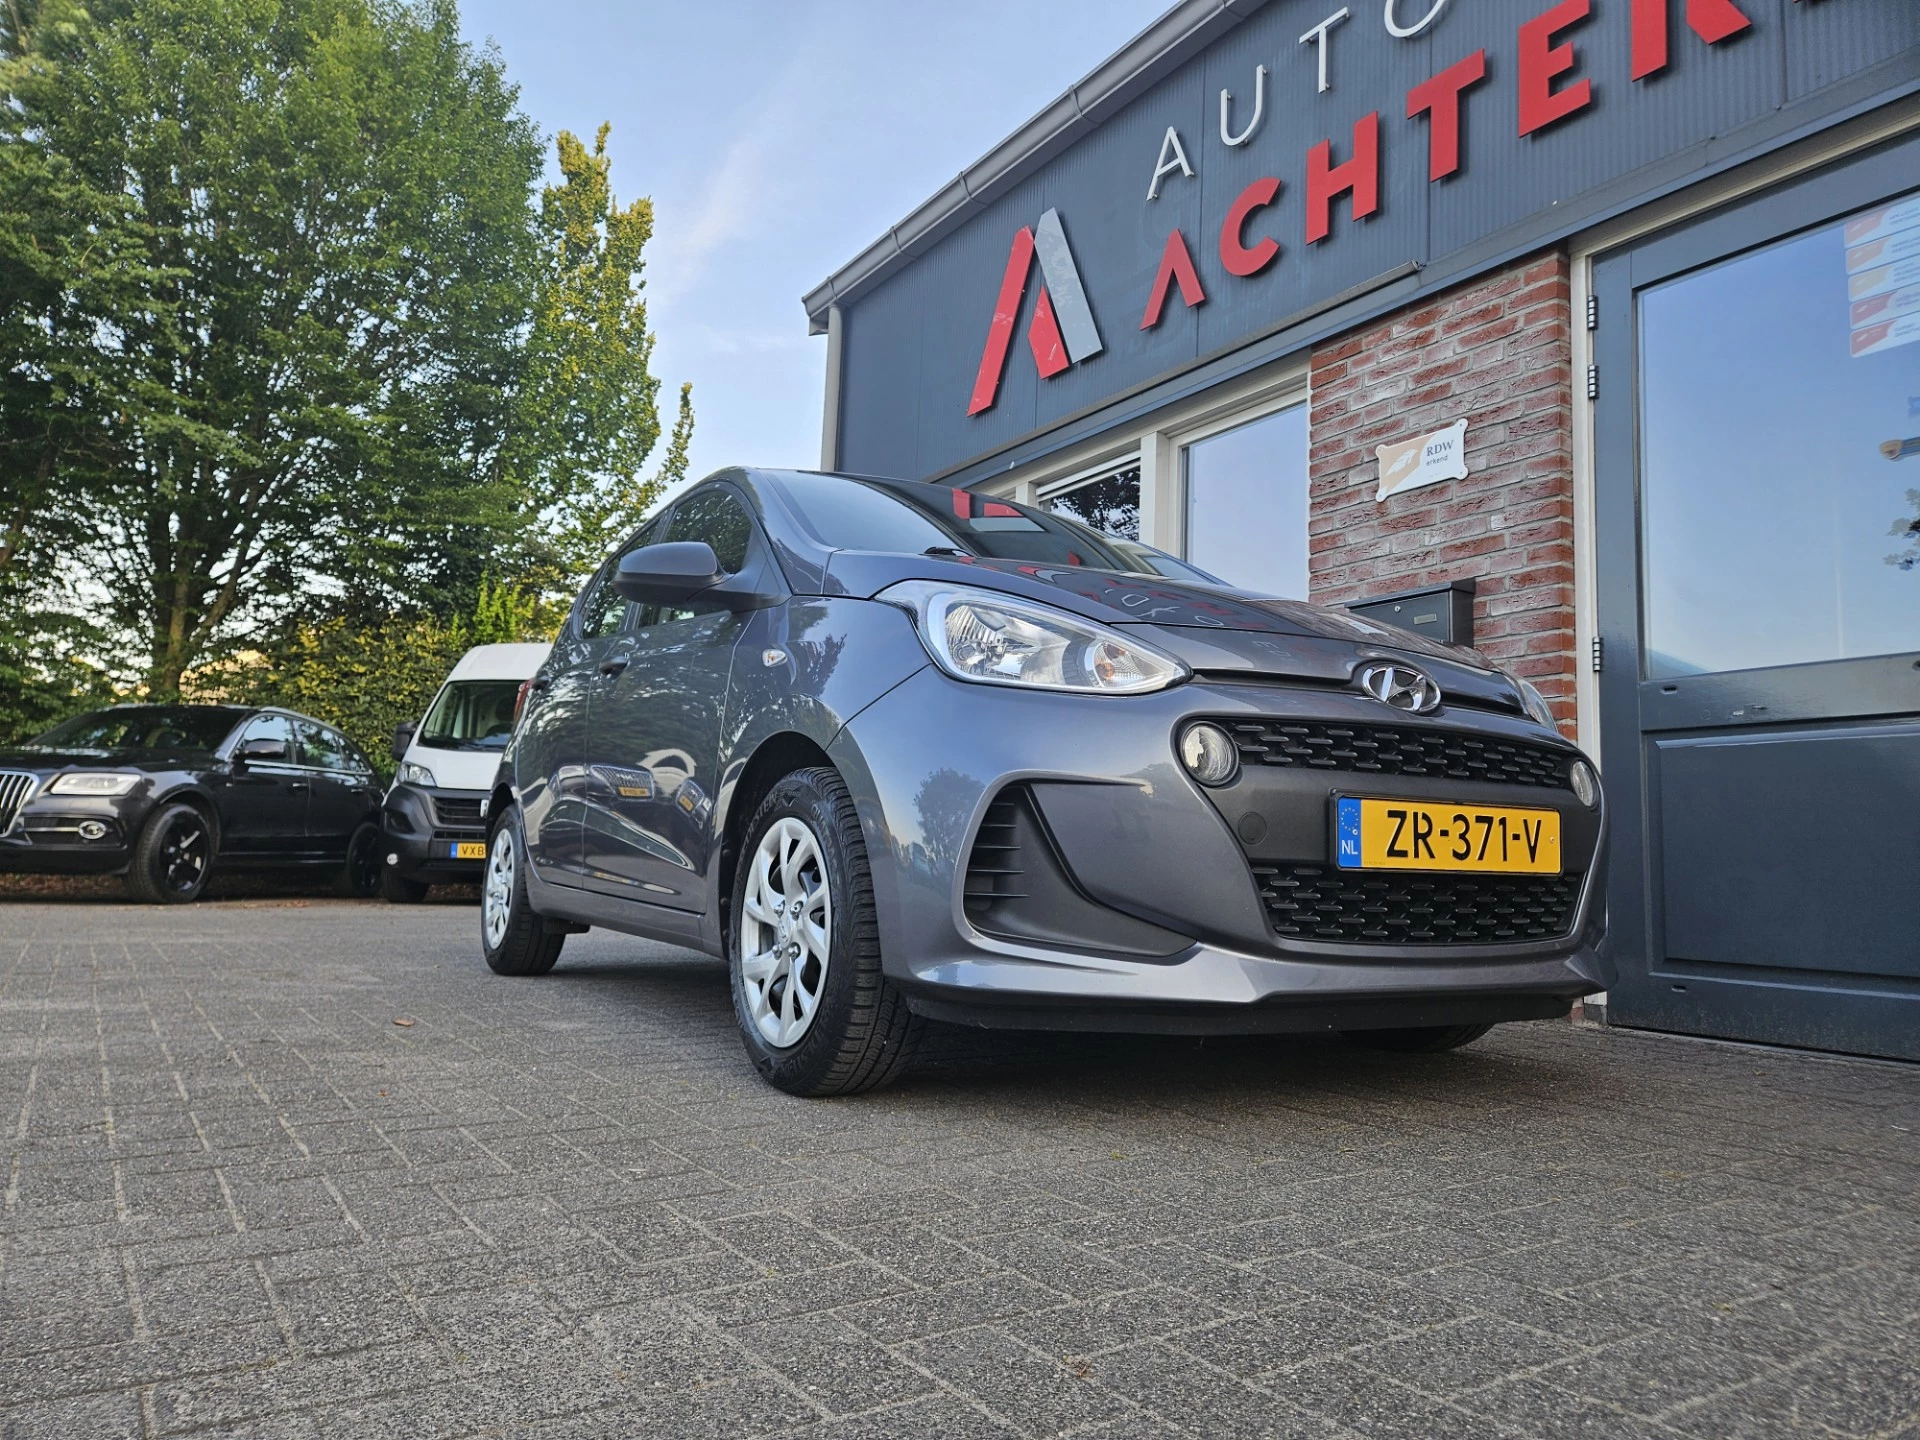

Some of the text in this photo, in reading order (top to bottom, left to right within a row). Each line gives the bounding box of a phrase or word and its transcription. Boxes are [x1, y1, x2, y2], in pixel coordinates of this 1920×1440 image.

[1426, 439, 1454, 456] RDW
[1426, 454, 1448, 466] erkend
[1341, 809, 1542, 864] NL ZR-371-V
